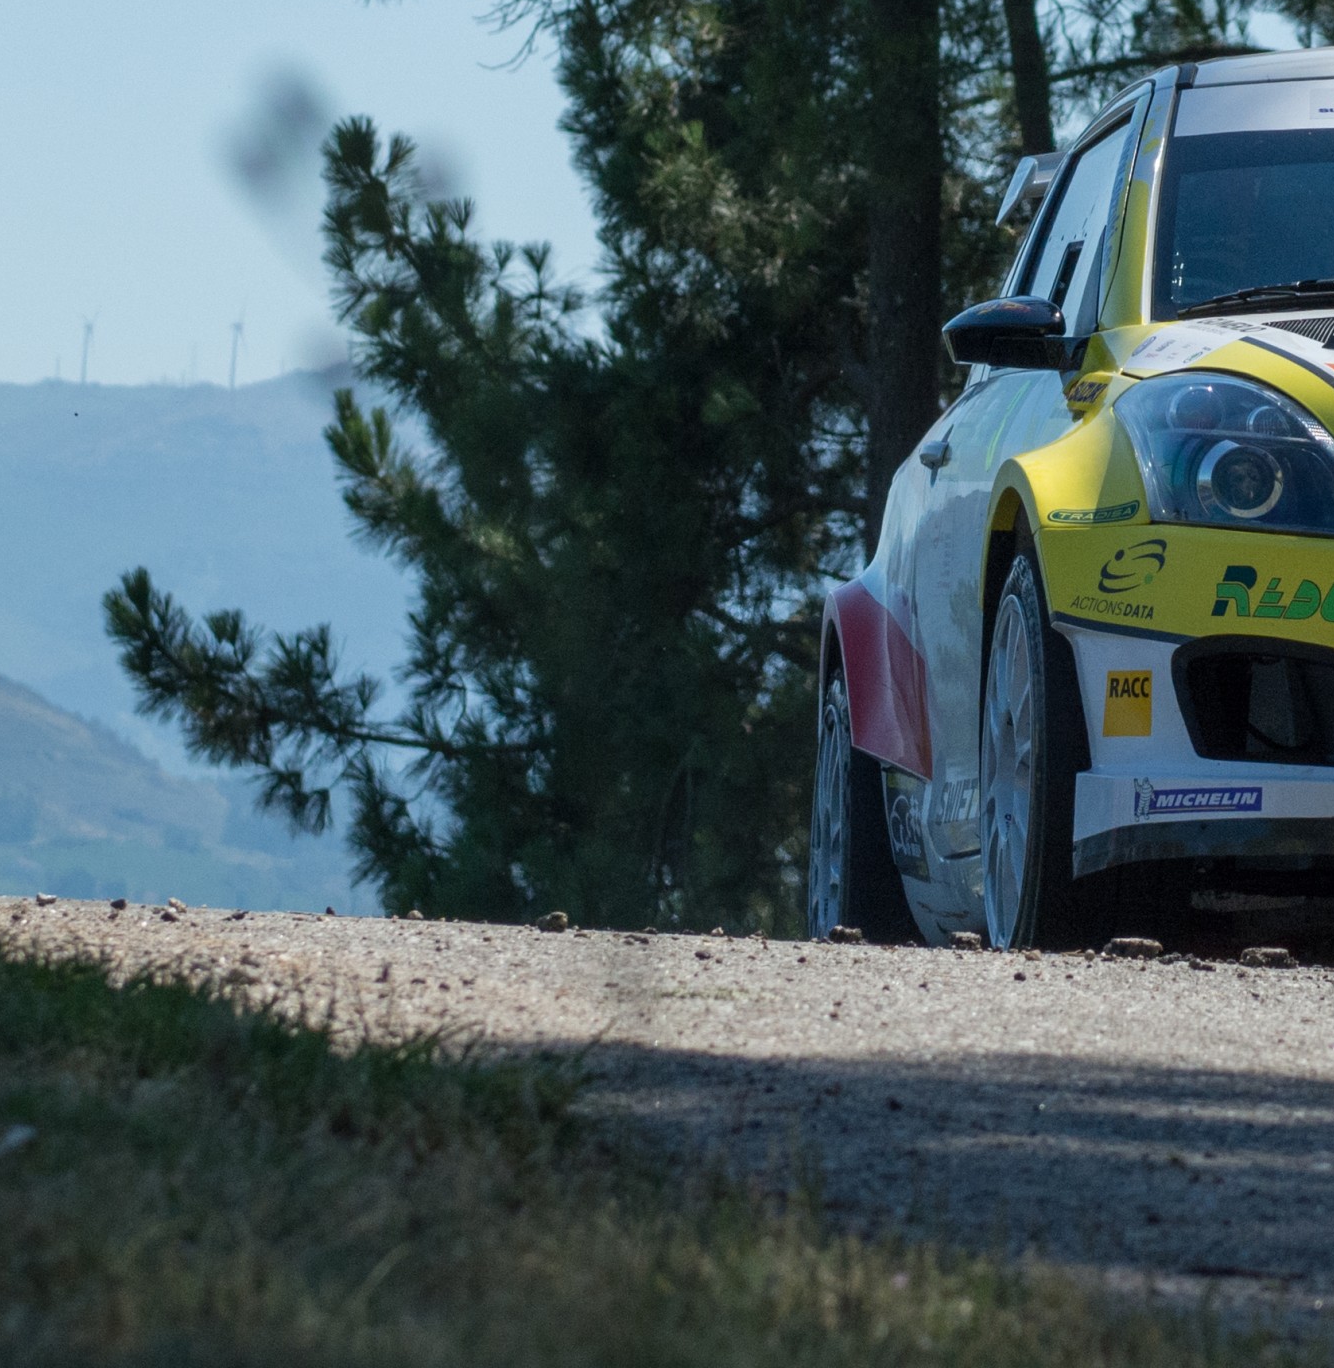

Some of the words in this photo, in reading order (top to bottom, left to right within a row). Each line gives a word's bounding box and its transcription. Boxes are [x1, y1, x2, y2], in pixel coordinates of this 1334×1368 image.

[1057, 503, 1135, 522] TRADISA
[1069, 594, 1154, 620] ACTIONSDATA
[1109, 676, 1150, 699] RACC
[1156, 790, 1259, 808] MICHELIN
